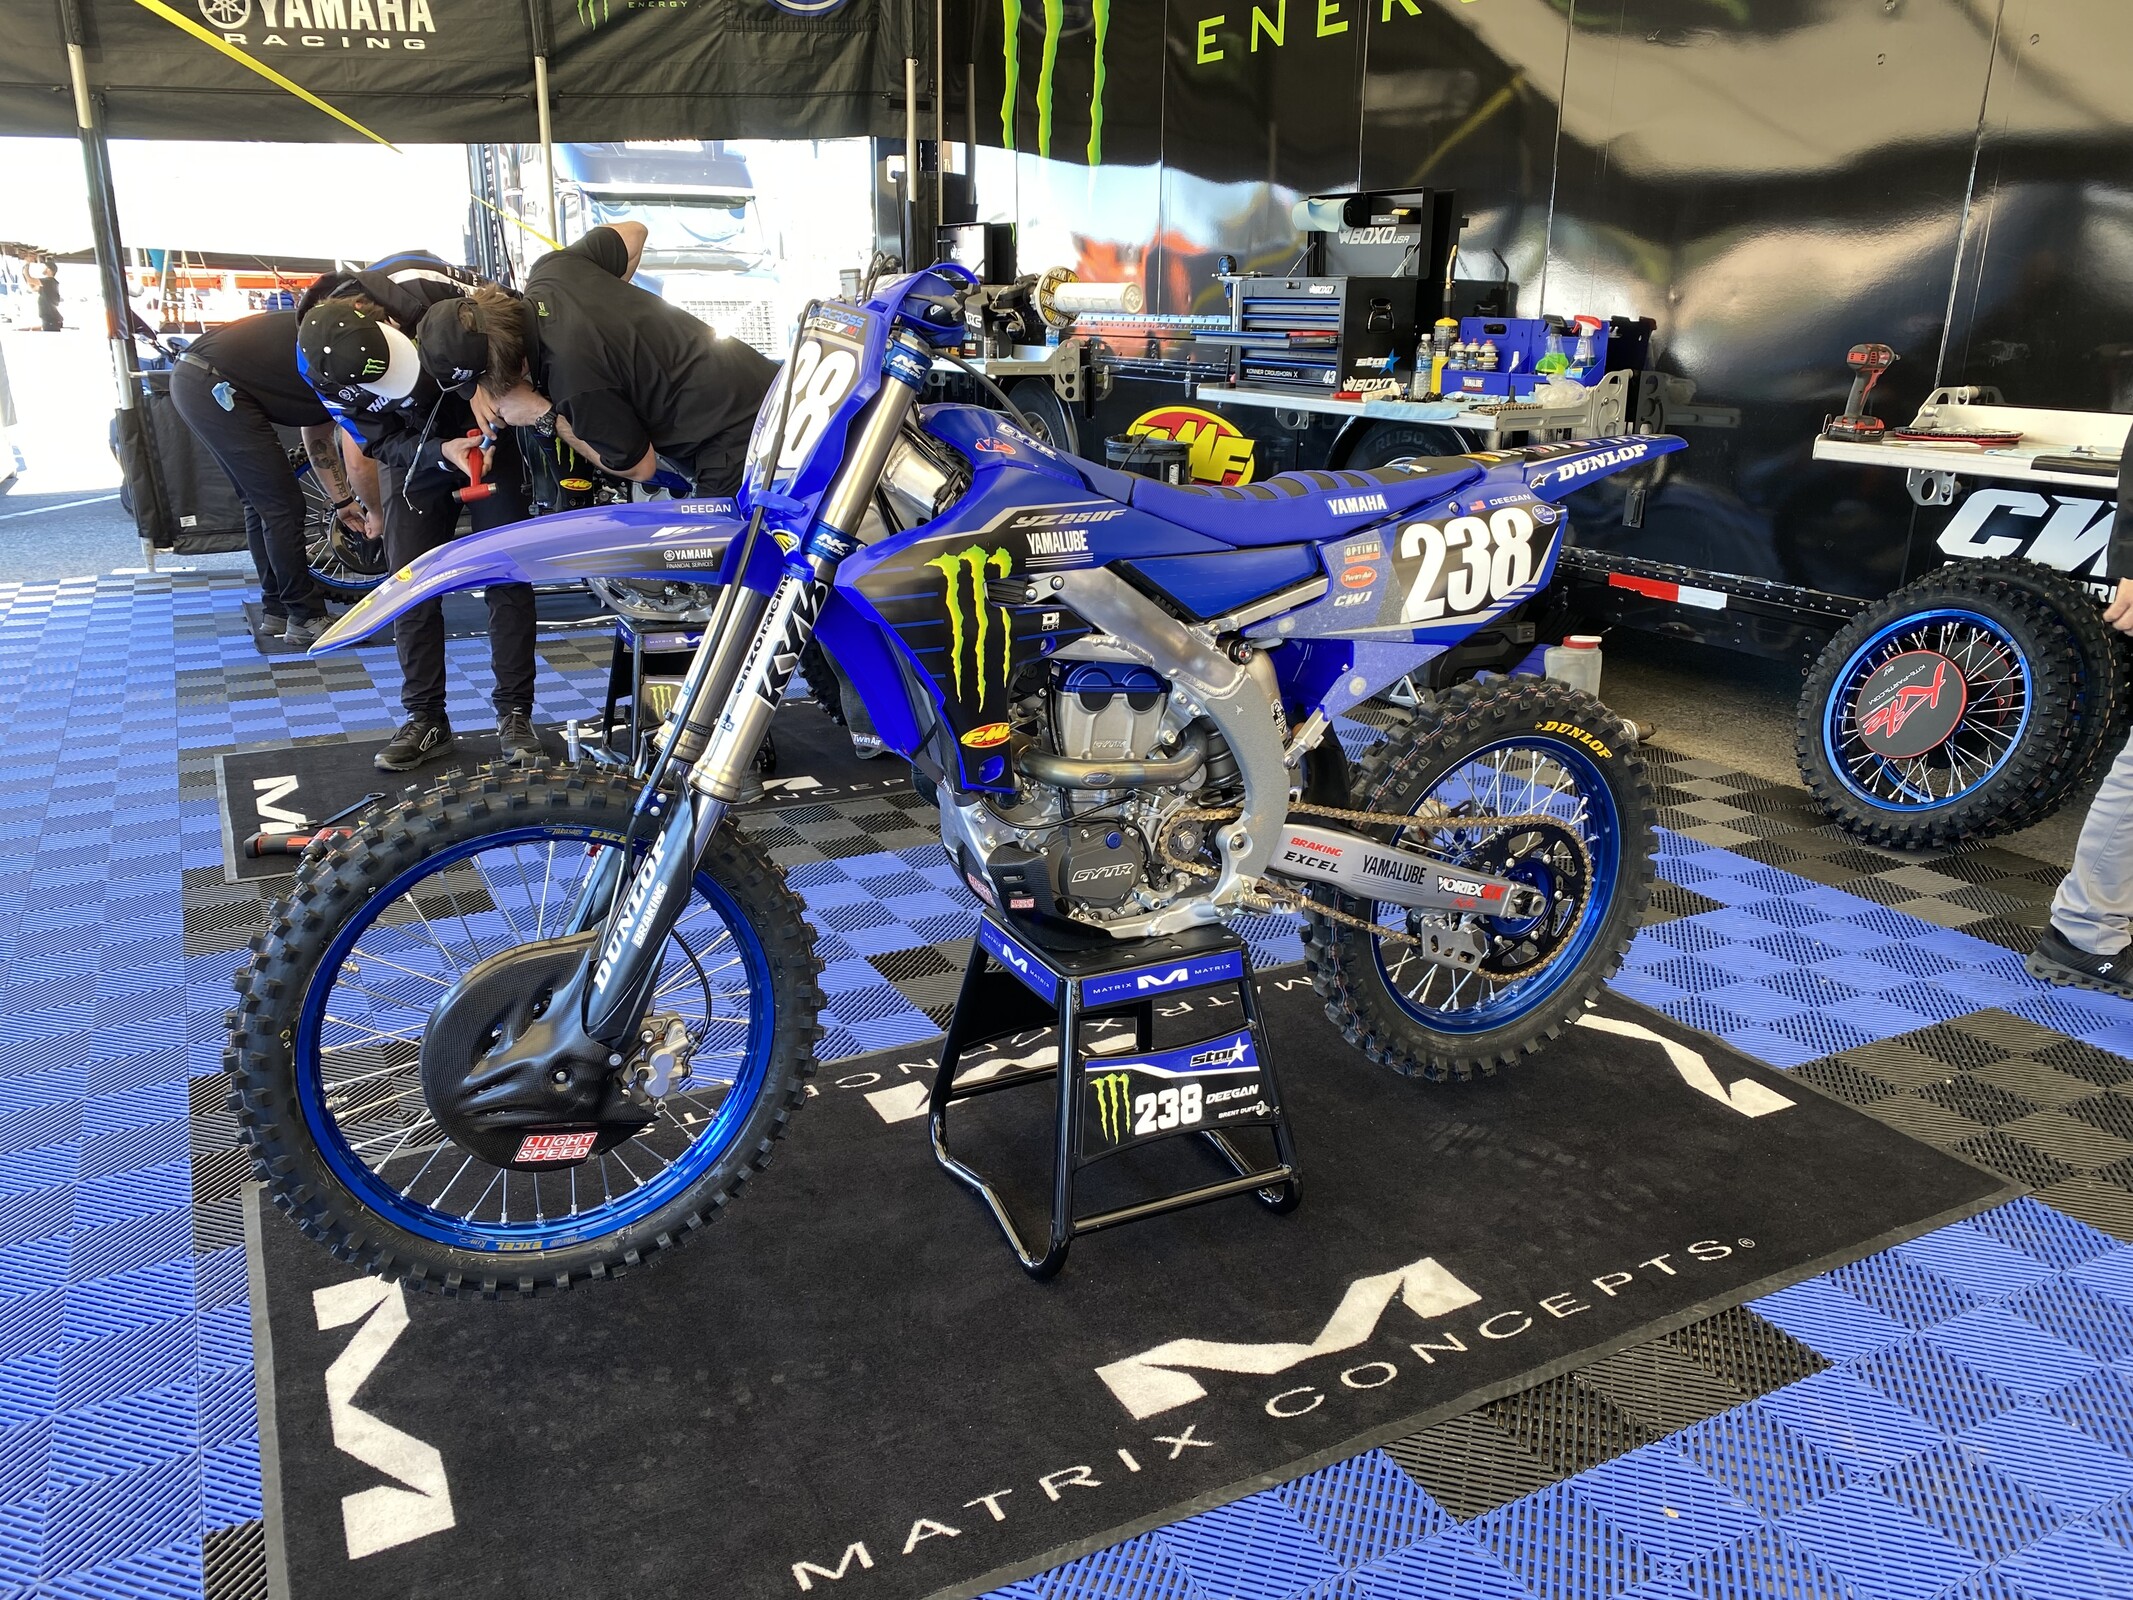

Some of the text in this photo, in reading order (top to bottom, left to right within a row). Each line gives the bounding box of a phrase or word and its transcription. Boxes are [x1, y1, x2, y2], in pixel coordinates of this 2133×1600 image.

[260, 0, 437, 33] YAMAHA
[223, 33, 427, 50] RACING
[1349, 226, 1397, 245] BOXO
[1322, 370, 1337, 384] 43
[366, 396, 393, 413] THO
[1556, 443, 1648, 482] DUNLOP
[681, 503, 732, 514] DEEGAN
[1327, 494, 1387, 516] YAMAHA
[1489, 493, 1531, 506] DEEGAN
[1010, 509, 1127, 529] YZ250F
[1026, 530, 1088, 555] YAMALUBE
[1936, 488, 2119, 578] CW
[674, 548, 714, 560] YAMAHA
[1346, 543, 1379, 555] OPTIMA
[666, 560, 714, 569] FINANCIAL SERVICES
[1400, 507, 1534, 624] 238
[1543, 721, 1613, 759] DUNLOP
[1290, 837, 1344, 857] BRAKING
[1071, 862, 1135, 883] GYTR
[1284, 851, 1339, 874] EXCEL
[1362, 855, 1428, 885] YAMALUBE
[1437, 875, 1485, 898] VORTEX
[594, 831, 666, 995] DUNLOP
[633, 880, 668, 949] BRAKING
[1194, 963, 1231, 975] MATRIX
[1093, 982, 1132, 994] MATRIX
[1206, 1084, 1259, 1105] DEEGAN
[1134, 1083, 1203, 1136] 238
[1218, 1108, 1240, 1119] BRENT
[525, 1133, 597, 1148] LIGHT
[518, 1147, 588, 1160] SPEED
[496, 1240, 543, 1251] EXCEL
[792, 1237, 1735, 1592] MATRIX CONCEPTS
